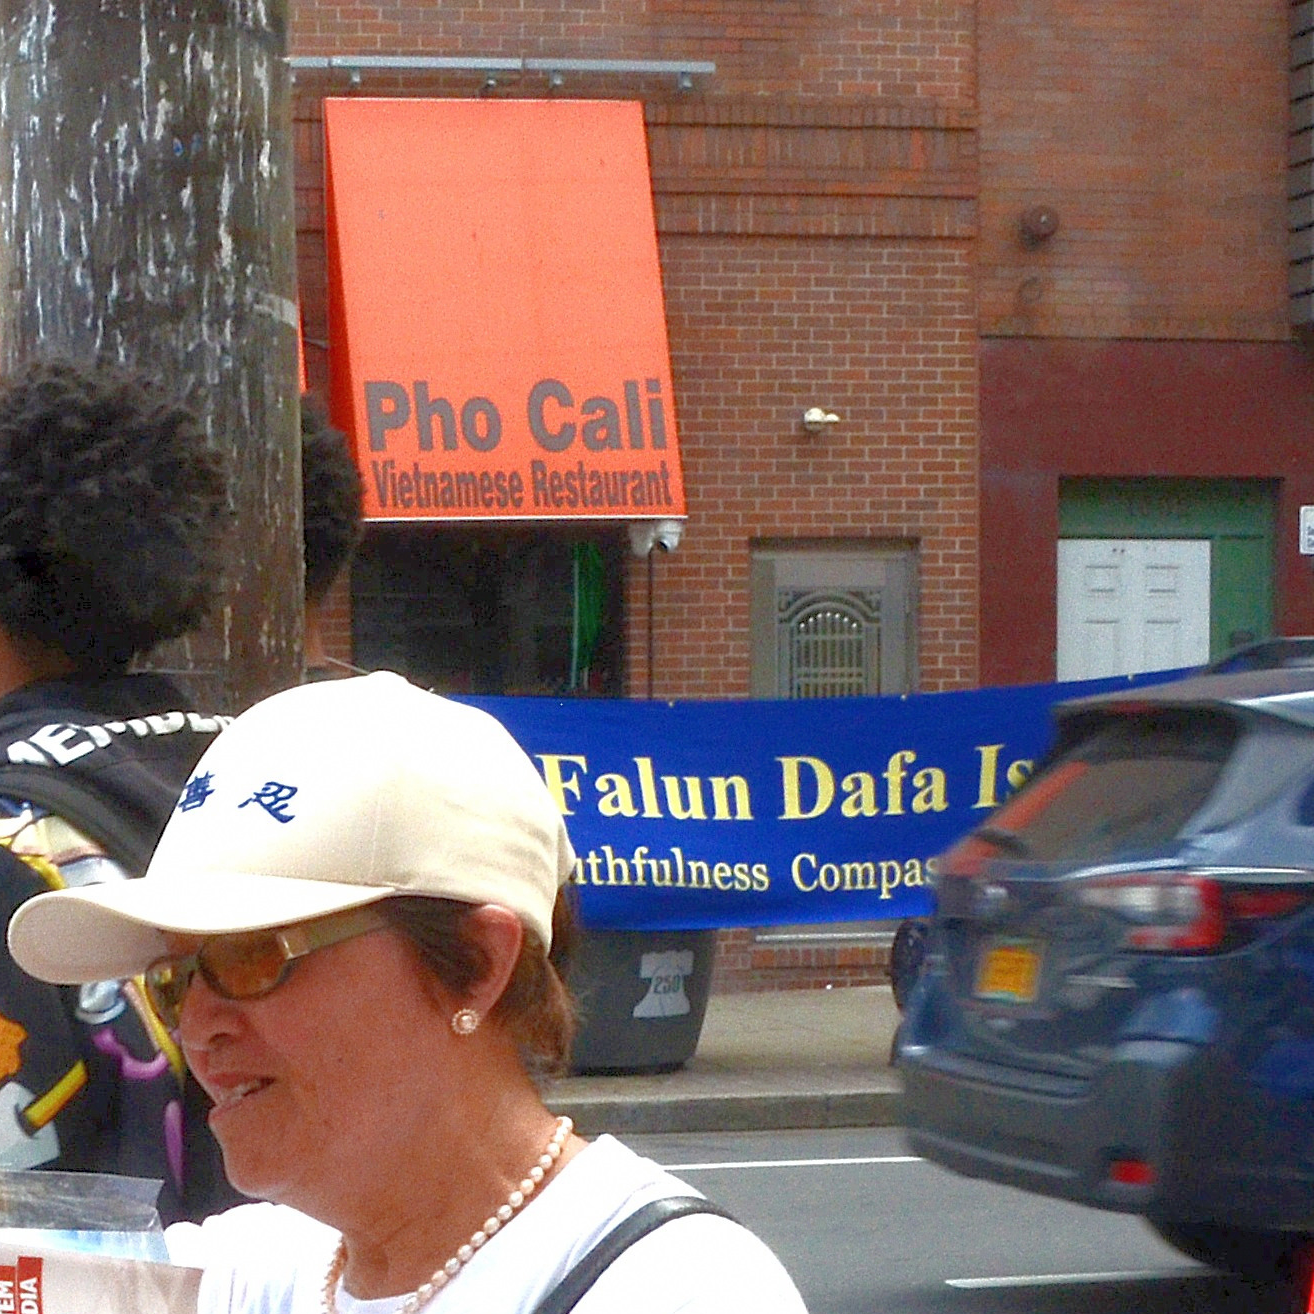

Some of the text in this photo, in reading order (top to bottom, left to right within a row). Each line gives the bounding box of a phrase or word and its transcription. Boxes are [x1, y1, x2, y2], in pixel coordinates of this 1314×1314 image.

[364, 378, 667, 452] Pho Cali
[371, 459, 675, 509] Vietnamese Restaurant
[534, 753, 754, 820] Falun
[775, 749, 949, 820] Dafa
